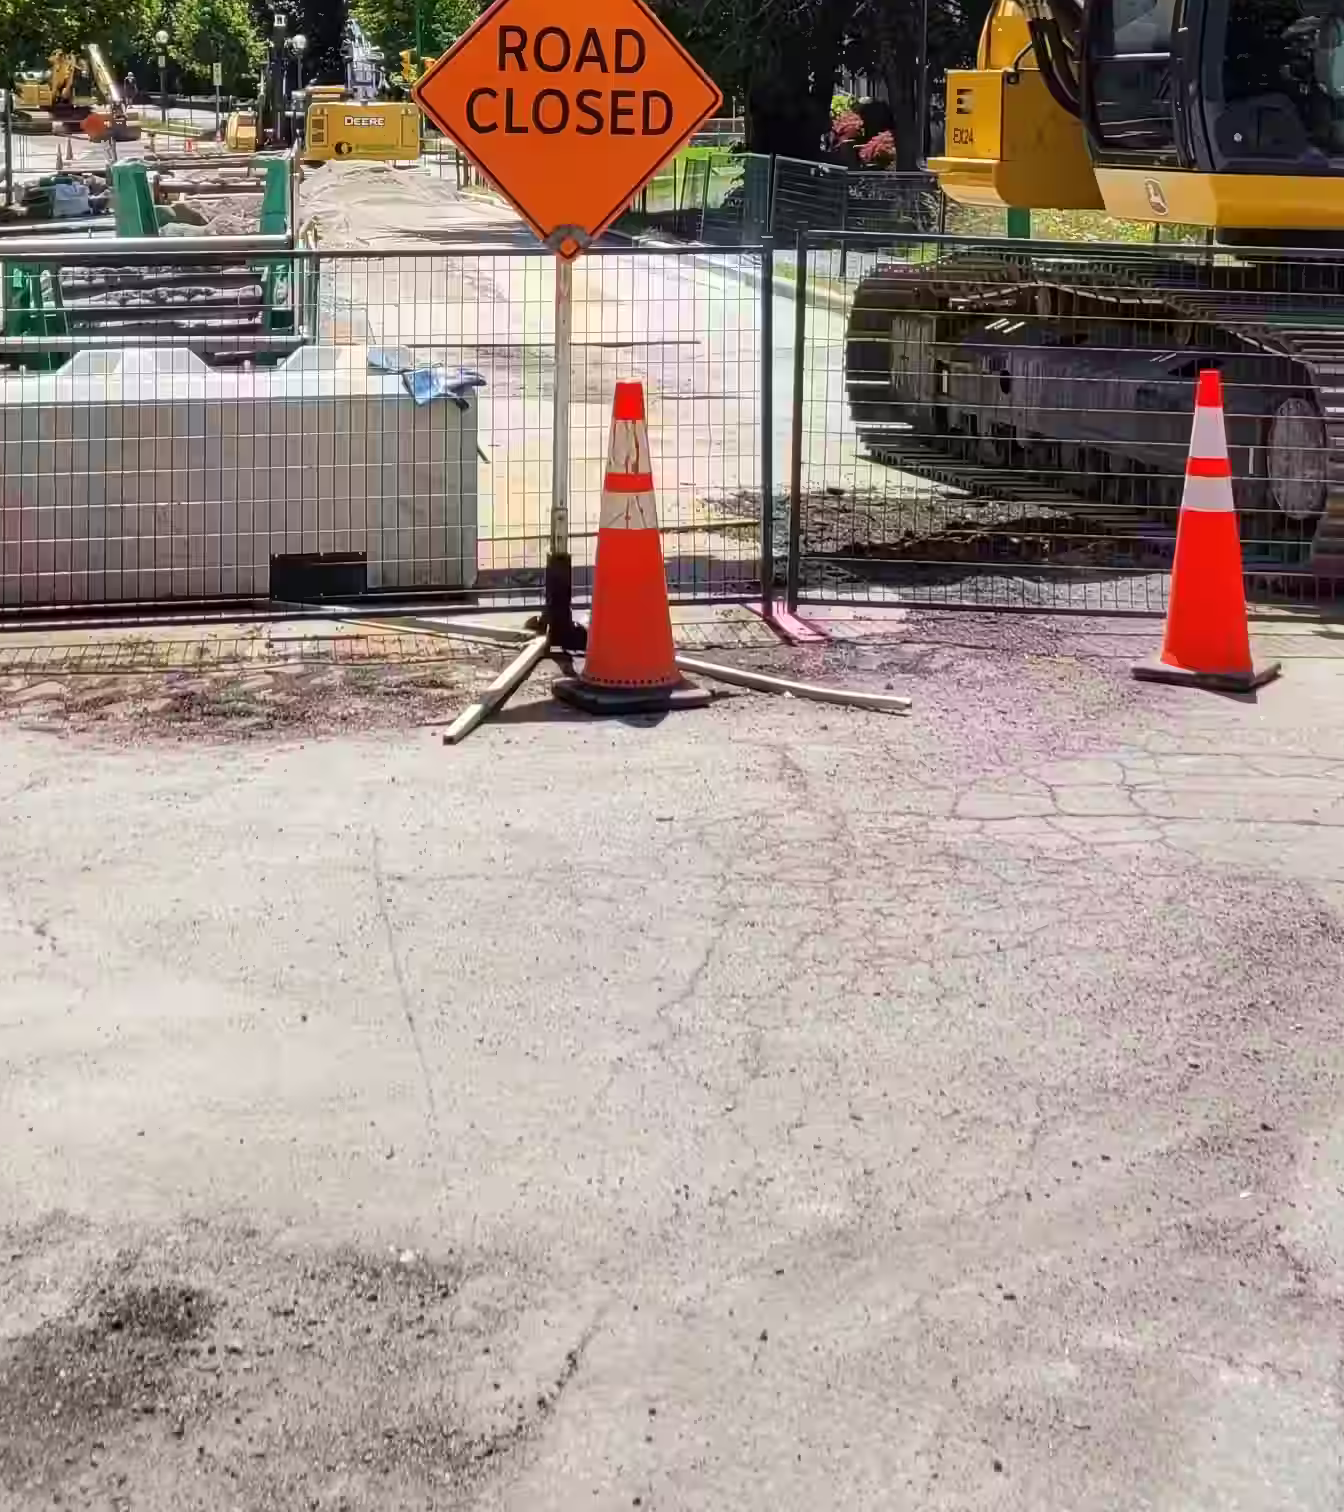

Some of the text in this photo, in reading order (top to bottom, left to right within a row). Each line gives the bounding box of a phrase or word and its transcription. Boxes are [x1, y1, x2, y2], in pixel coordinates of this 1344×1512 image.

[497, 25, 647, 73] ROAD
[344, 115, 385, 126] DEERE
[465, 87, 674, 136] CLOSED
